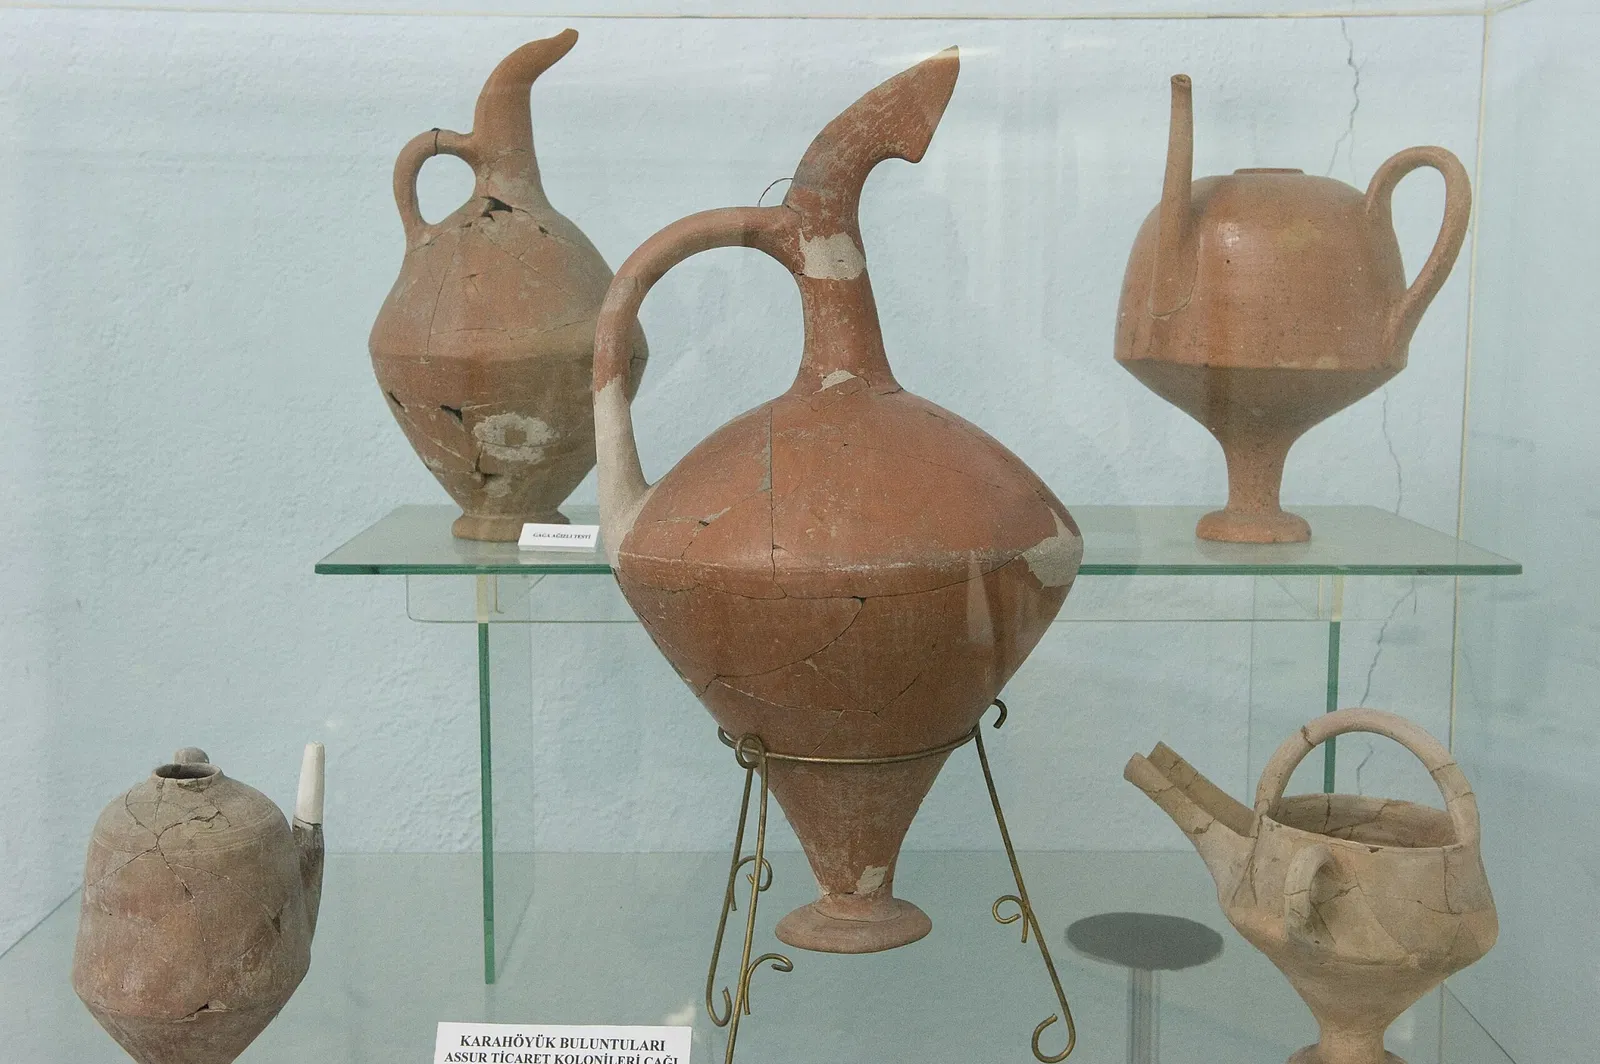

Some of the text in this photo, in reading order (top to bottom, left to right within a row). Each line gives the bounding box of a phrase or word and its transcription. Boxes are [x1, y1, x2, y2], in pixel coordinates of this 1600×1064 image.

[460, 1033, 666, 1051] KARAHÖYÜK BULUNTULARI
[444, 1051, 488, 1063] ASSUR
[491, 1050, 551, 1064] TİCARET
[554, 1052, 640, 1064] KOLONİLERİ
